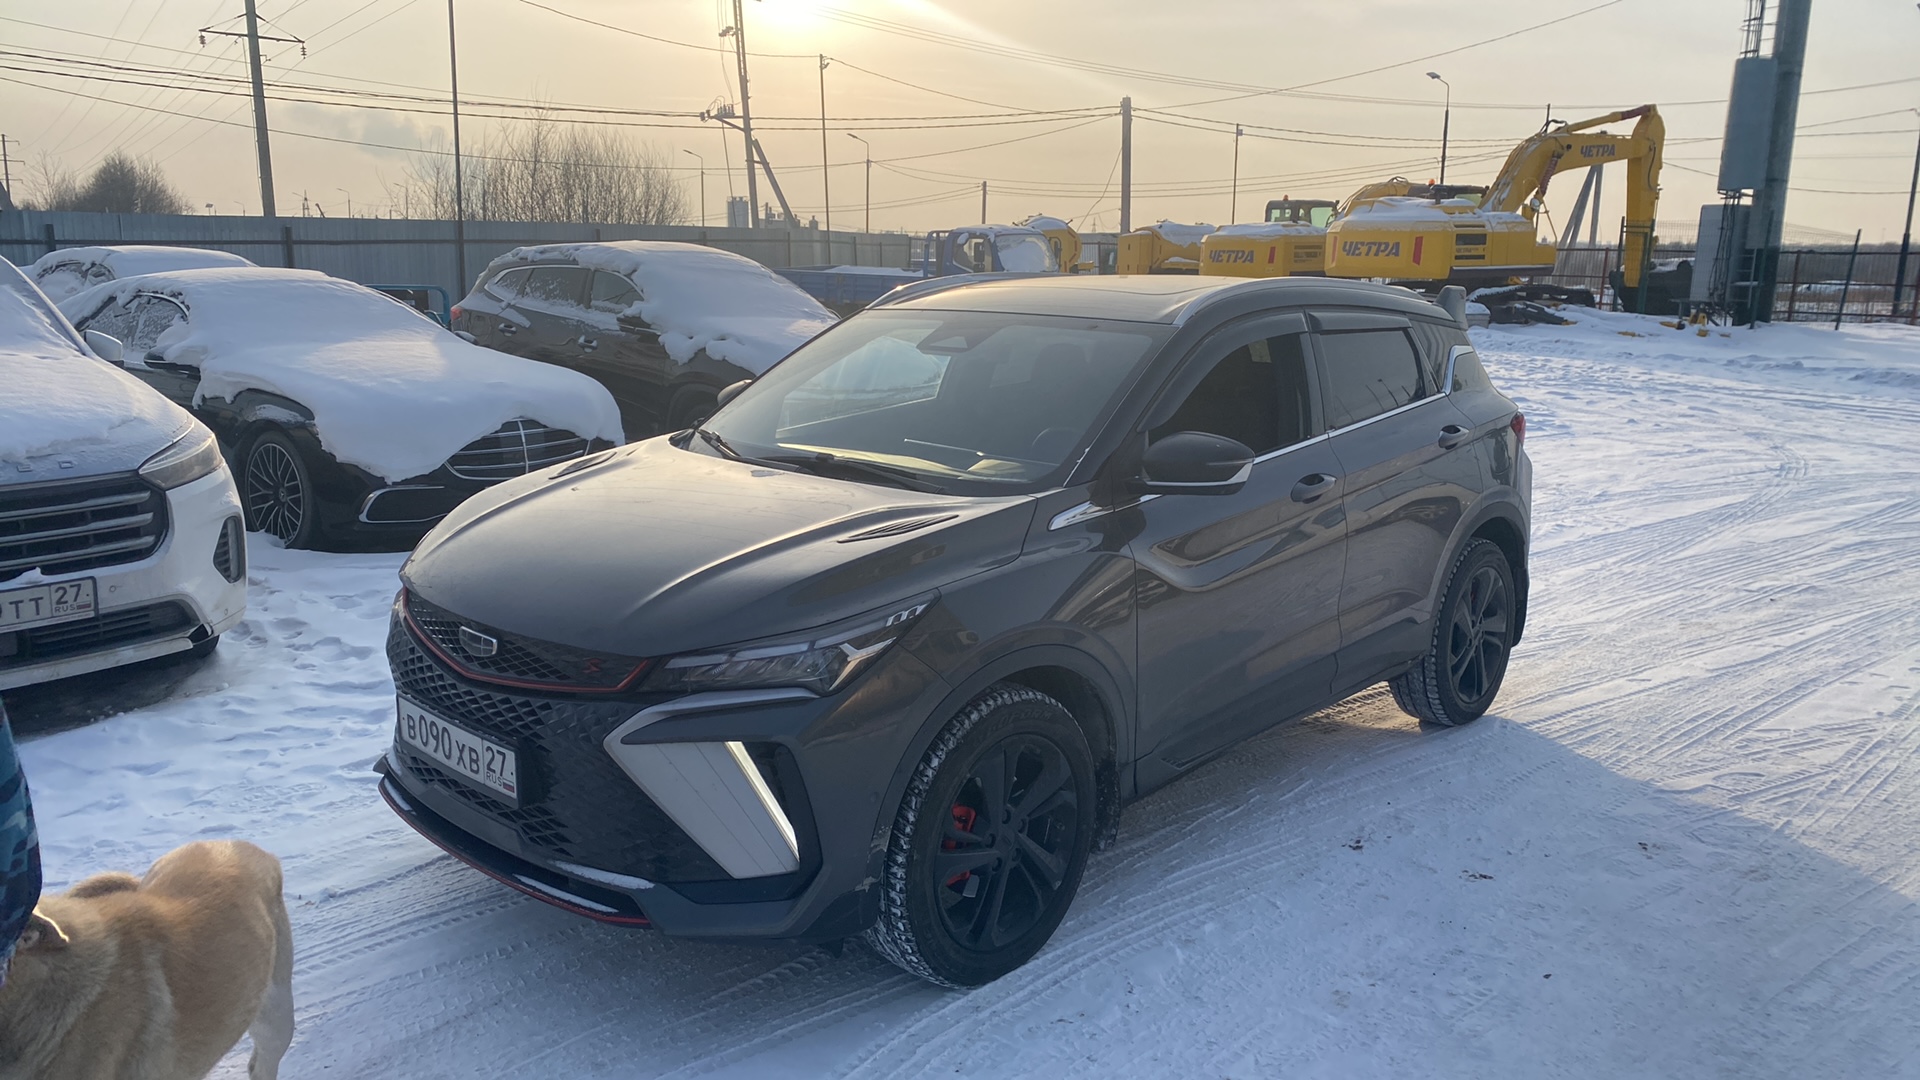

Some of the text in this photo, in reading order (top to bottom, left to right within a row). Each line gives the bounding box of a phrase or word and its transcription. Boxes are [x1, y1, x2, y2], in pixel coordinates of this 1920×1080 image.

[1580, 144, 1616, 158] ЧЕТРА
[1208, 249, 1255, 264] ЧЕТРА
[1342, 241, 1401, 257] ЧЕТРА
[0, 597, 44, 619] ТТ
[54, 583, 82, 605] 27
[54, 603, 77, 613] RUS
[485, 745, 507, 777] 27
[486, 771, 504, 787] RUS
